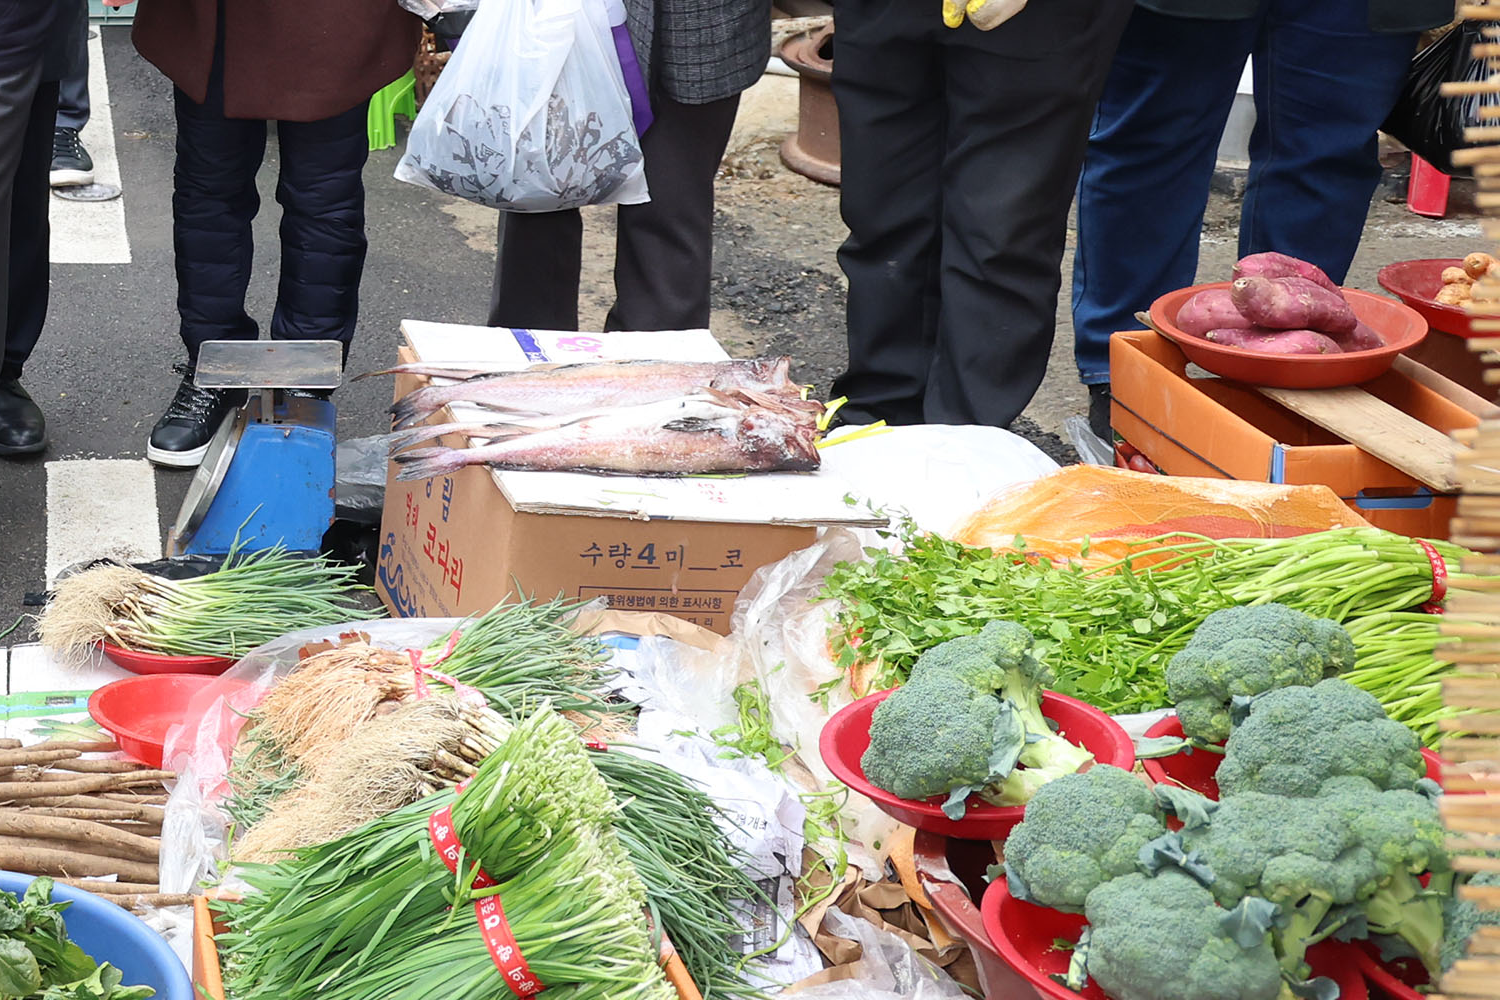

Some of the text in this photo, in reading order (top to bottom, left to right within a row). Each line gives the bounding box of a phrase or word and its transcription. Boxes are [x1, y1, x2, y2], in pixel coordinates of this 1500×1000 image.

[423, 521, 463, 607] 코다리
[579, 541, 633, 569] 수량
[637, 542, 657, 565] 4
[719, 548, 744, 569] 코
[597, 593, 723, 610] 품위생법에 의한 표시사항
